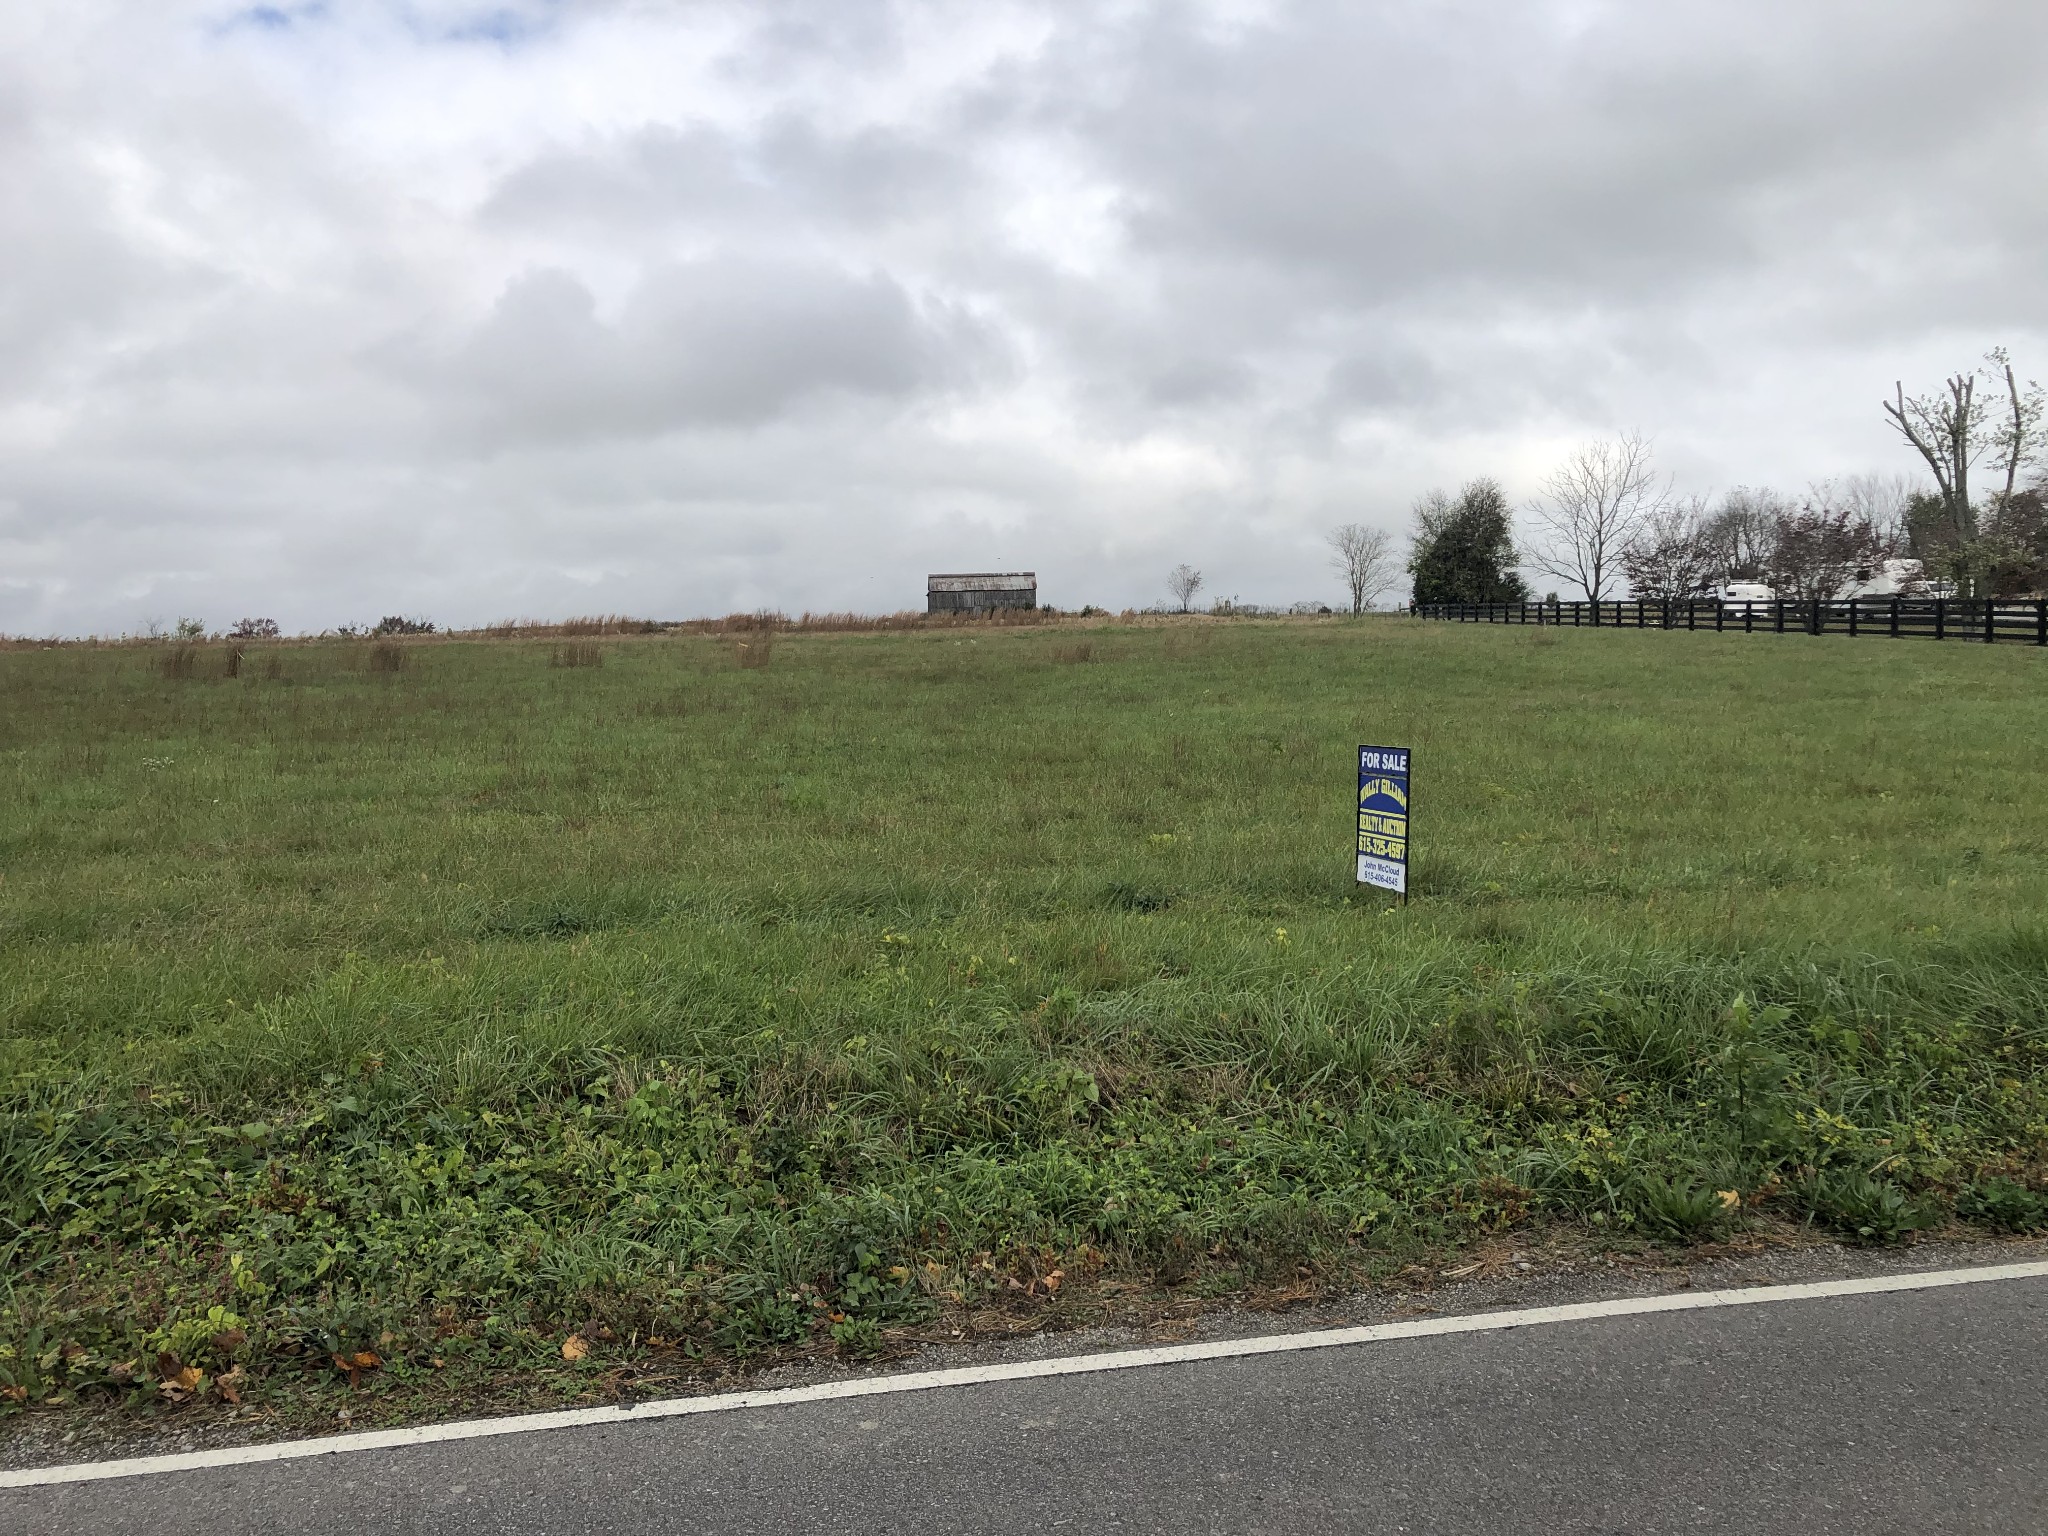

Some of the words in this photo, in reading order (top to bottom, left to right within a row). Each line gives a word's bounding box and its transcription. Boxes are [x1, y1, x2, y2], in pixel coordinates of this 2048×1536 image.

[1362, 752, 1380, 768] FOR
[1382, 754, 1406, 772] SALE
[1383, 818, 1406, 837] AUCTION
[1359, 836, 1405, 860] 615-325-4597
[1364, 860, 1377, 870] John
[1378, 863, 1400, 876] McCloud
